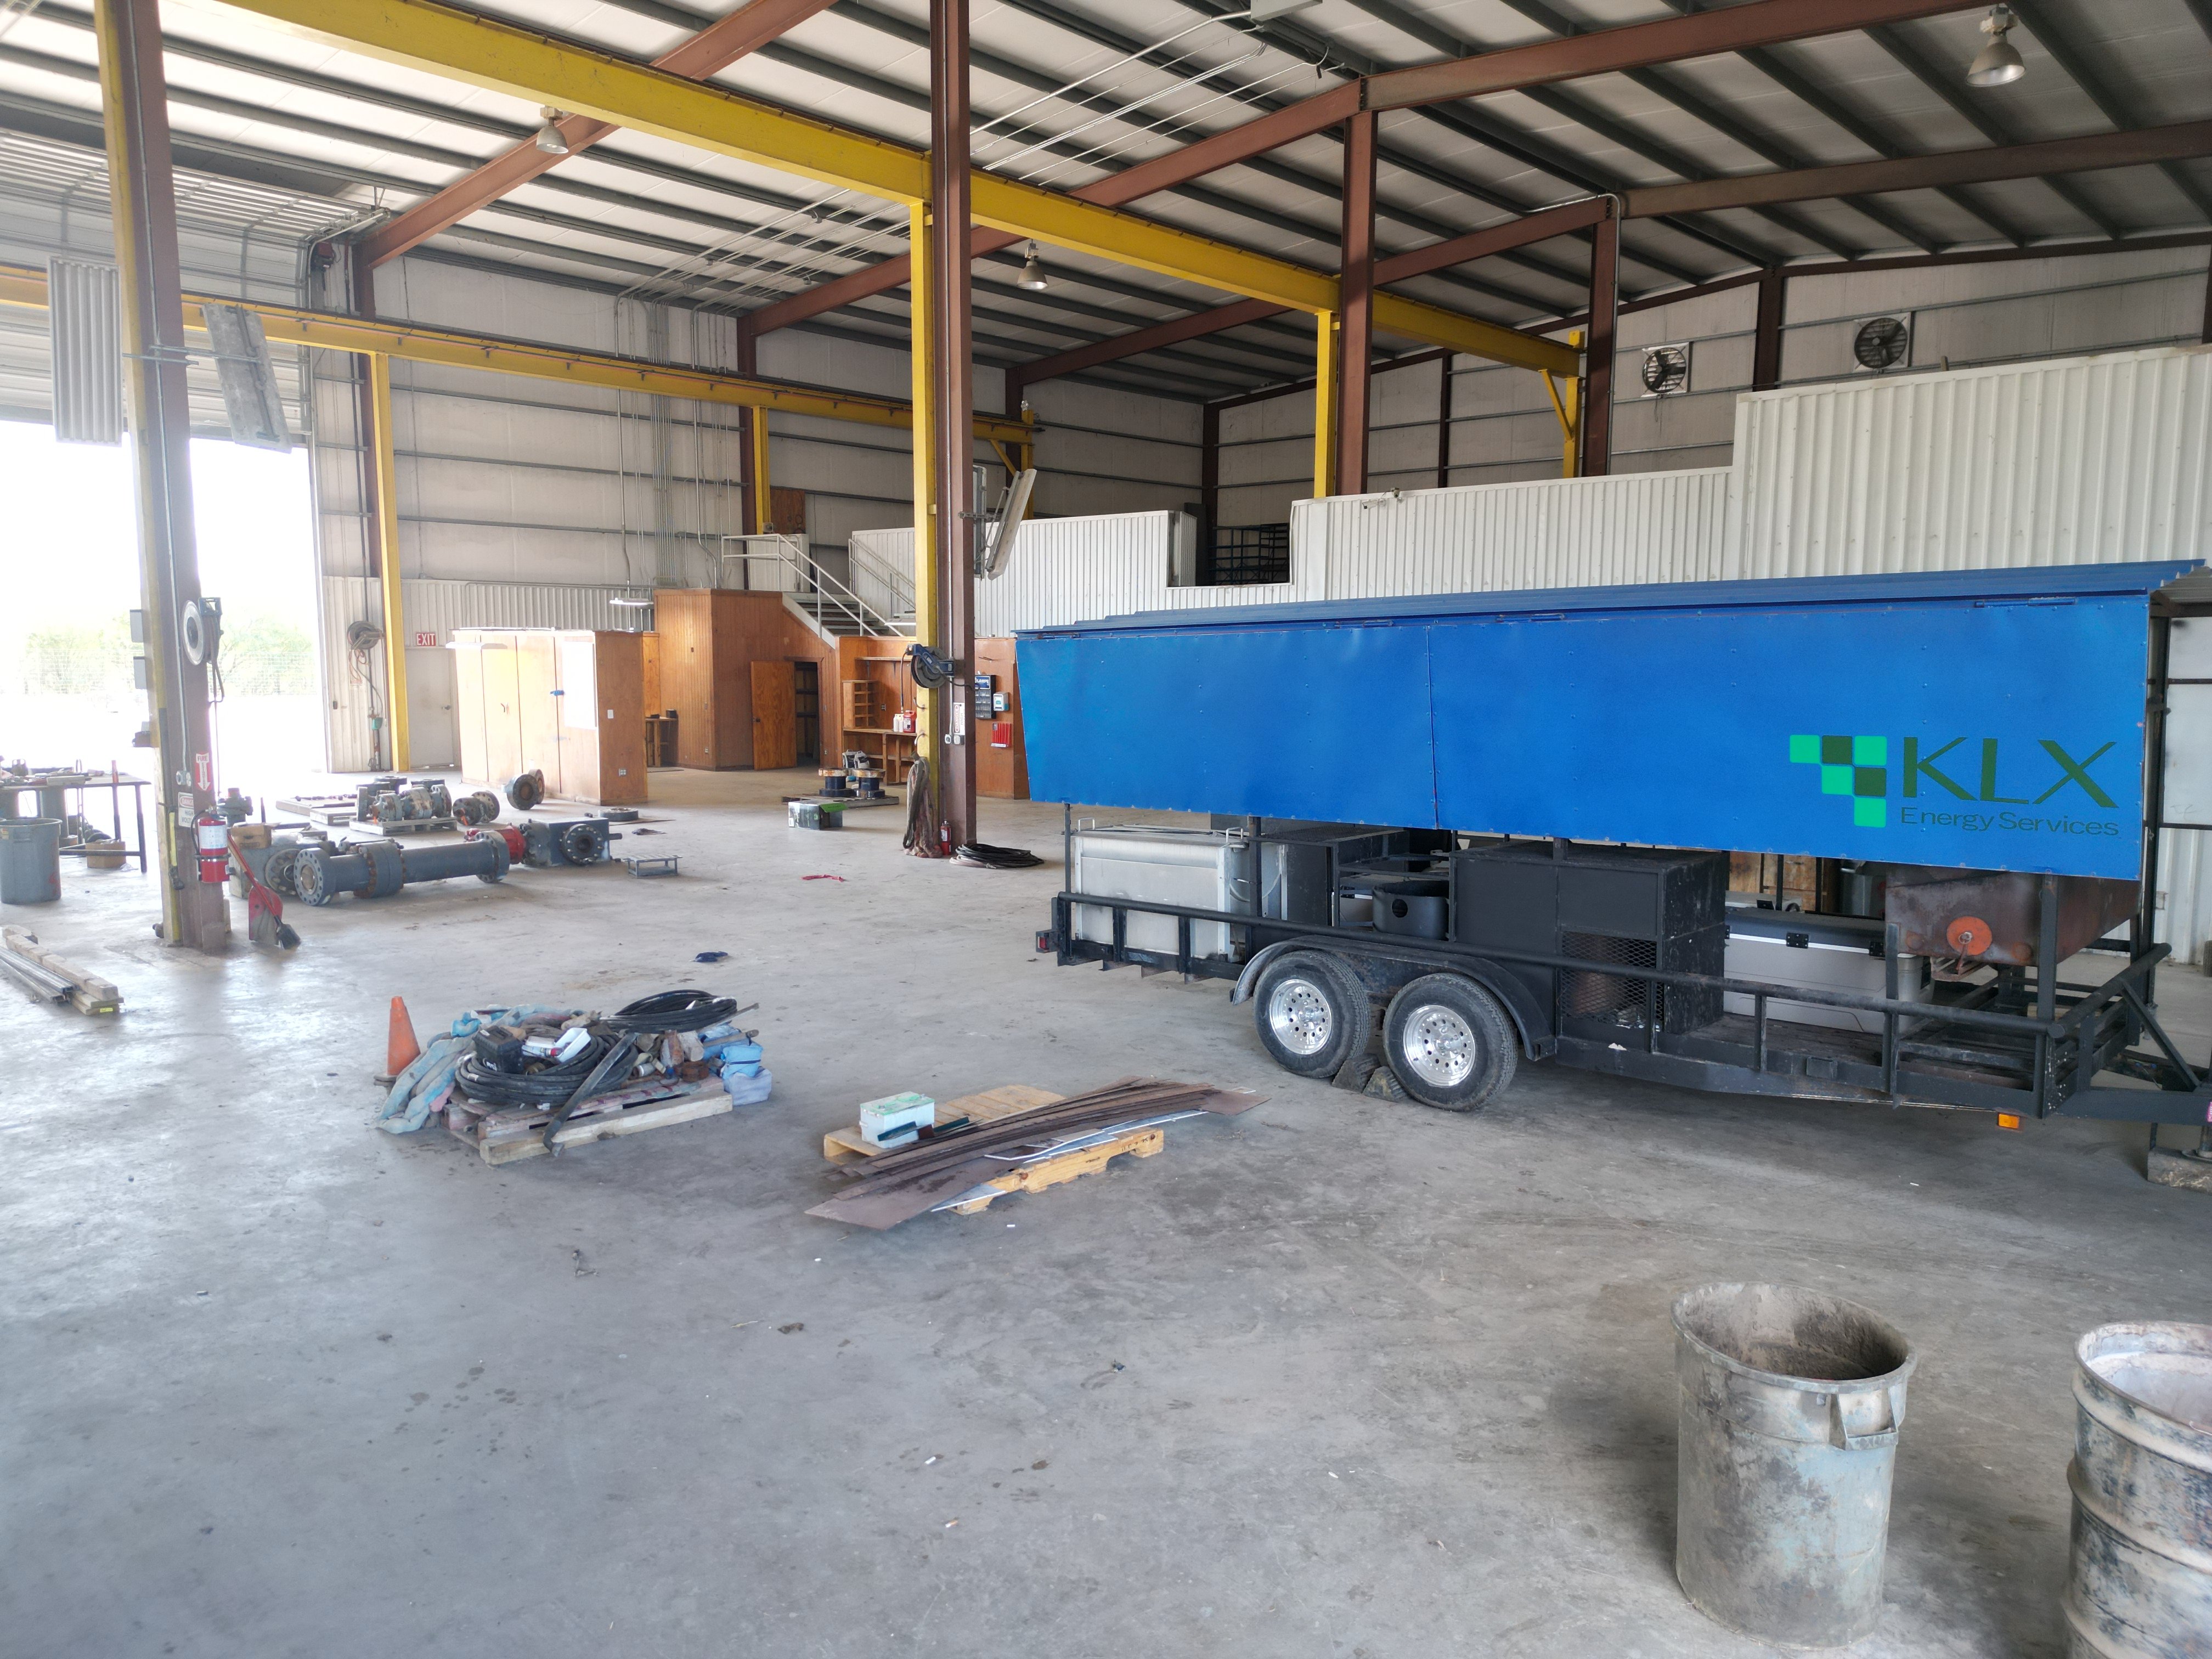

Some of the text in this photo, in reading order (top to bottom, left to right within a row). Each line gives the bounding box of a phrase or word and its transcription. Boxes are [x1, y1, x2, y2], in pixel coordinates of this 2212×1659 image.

[416, 633, 435, 646] EXIT
[1903, 737, 2119, 808] KLX
[1901, 806, 2119, 836] Energy Services
